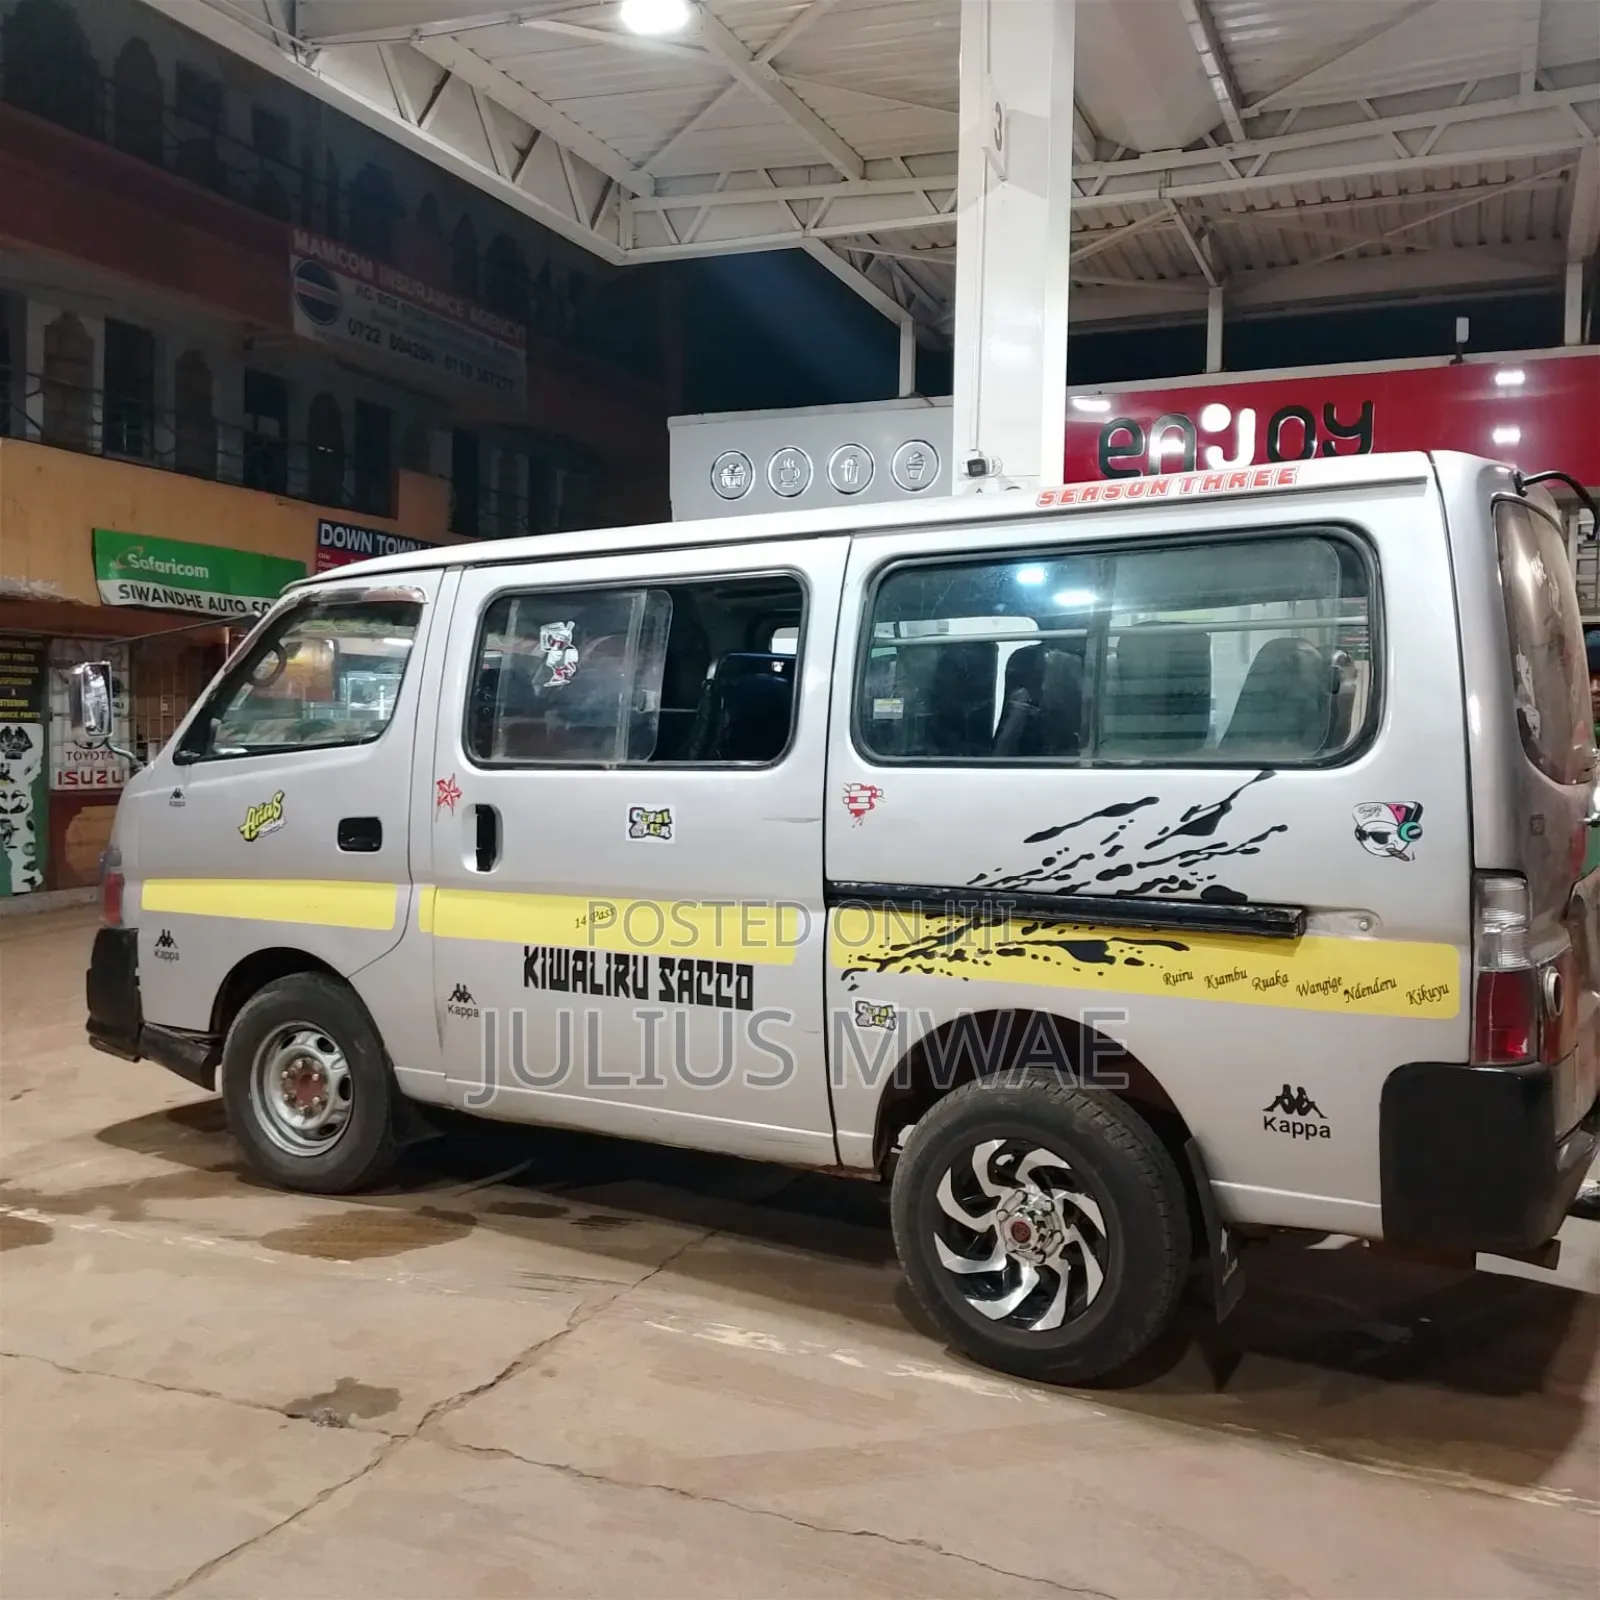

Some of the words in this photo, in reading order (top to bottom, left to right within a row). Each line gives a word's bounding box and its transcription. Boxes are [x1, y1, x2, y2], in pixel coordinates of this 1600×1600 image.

[379, 263, 466, 318] INSURANCE
[1037, 477, 1170, 507] SEASON
[1178, 466, 1299, 496] THREE
[320, 523, 373, 554] DOWN
[127, 553, 209, 579] Safaricom
[118, 584, 203, 609] SIWANDHE
[209, 597, 247, 613] AUTO
[66, 750, 116, 761] TOYOTA
[58, 769, 125, 786] ISUZU
[574, 916, 587, 929] 14
[589, 907, 616, 923] Pass
[154, 949, 180, 962] Kappa
[523, 945, 649, 1001] KIWALIRU
[658, 956, 754, 1011] SACCO
[1162, 969, 1194, 987] Ruiru
[1203, 966, 1249, 990] Kiambu
[1251, 969, 1289, 992] Ruaka
[1296, 974, 1344, 999] Wangige
[1343, 976, 1398, 1004] Ndenderu
[1406, 982, 1450, 1006] Kikuyu
[447, 1004, 480, 1020] Kappa
[1263, 1115, 1332, 1141] Kappa
